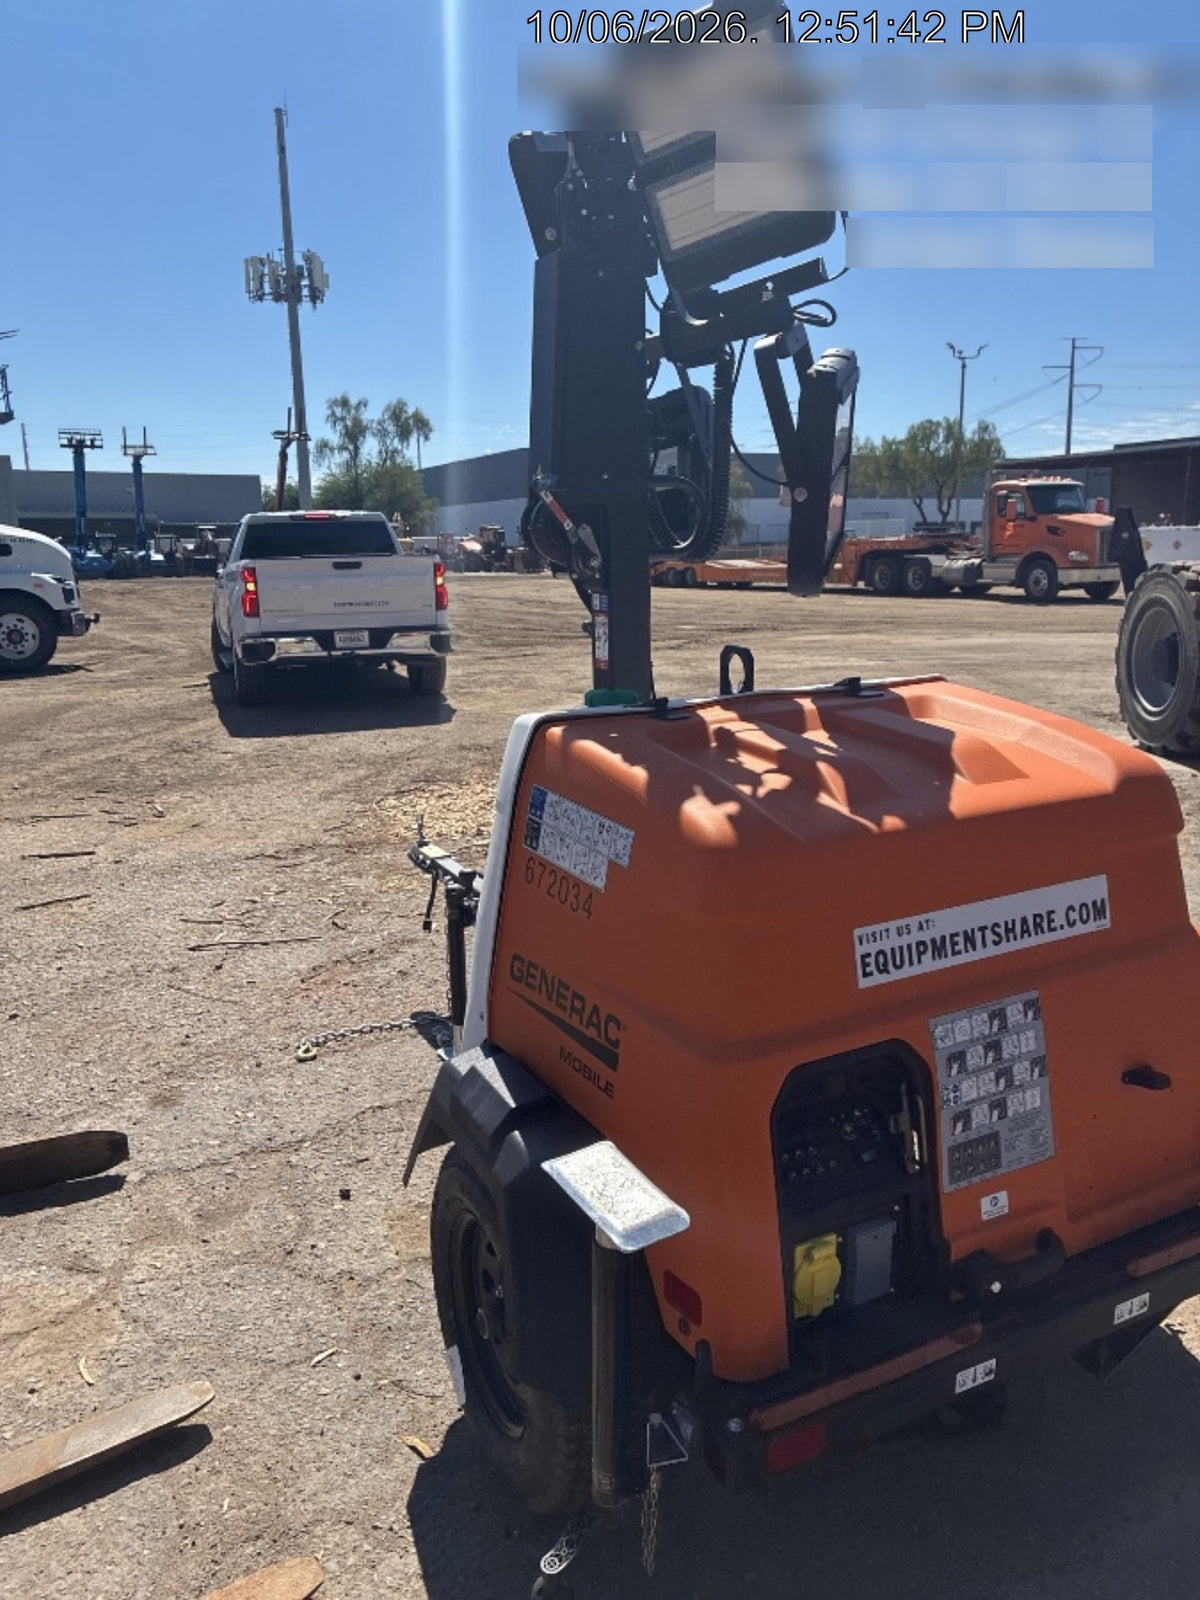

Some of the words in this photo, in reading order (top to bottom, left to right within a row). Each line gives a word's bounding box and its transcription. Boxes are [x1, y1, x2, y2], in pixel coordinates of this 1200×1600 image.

[524, 857, 594, 920] 672034
[857, 928, 890, 946] VISIT
[896, 924, 911, 937] US
[917, 919, 936, 932] AT:
[860, 898, 1108, 978] EQUIPMENTSHARE.COM
[509, 953, 622, 1050] GENERAC
[559, 1046, 615, 1099] MOBILE
